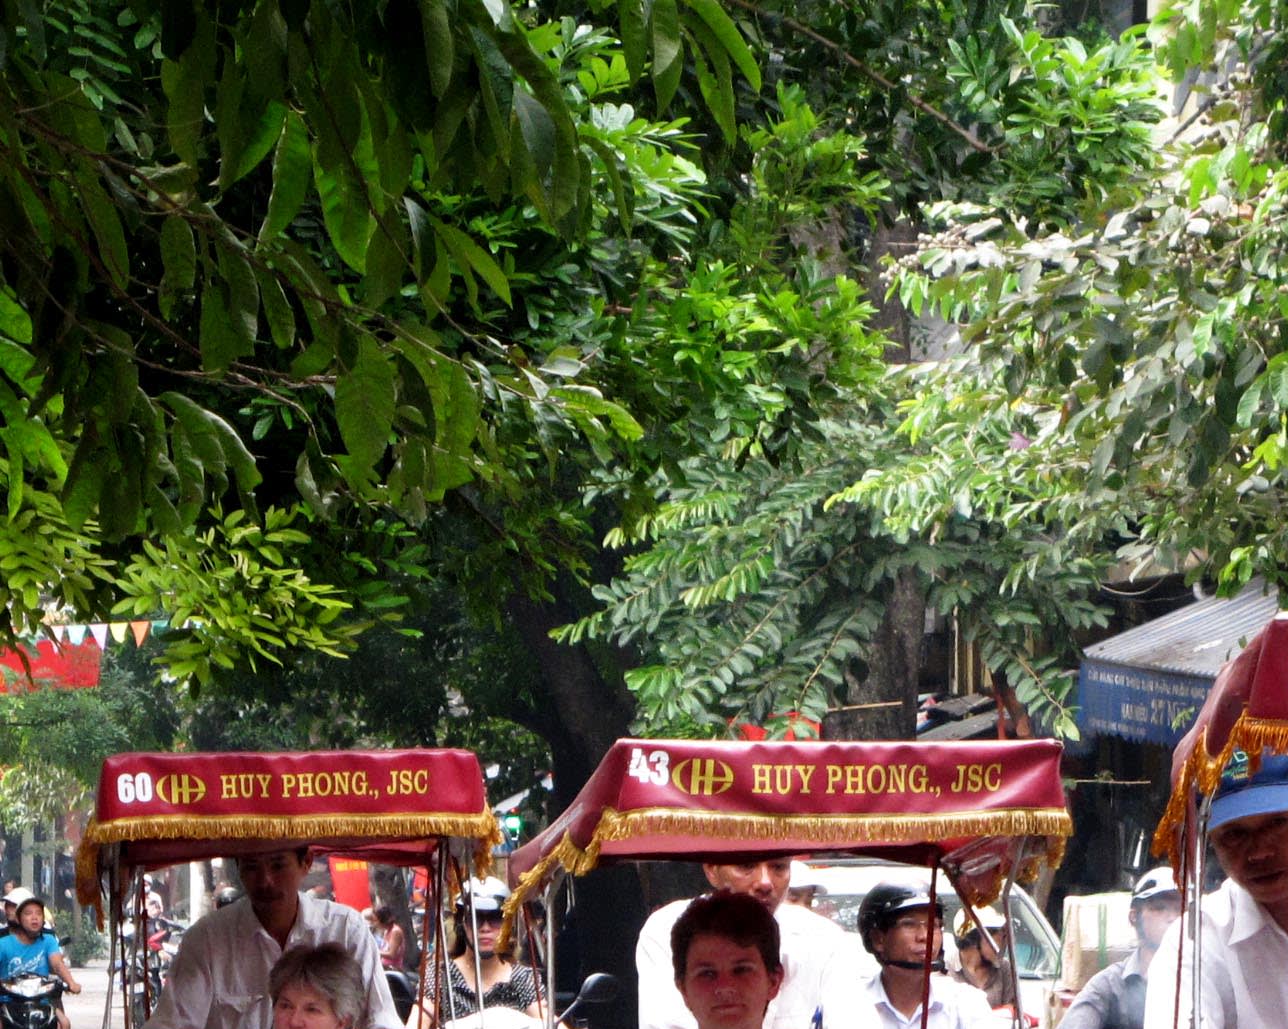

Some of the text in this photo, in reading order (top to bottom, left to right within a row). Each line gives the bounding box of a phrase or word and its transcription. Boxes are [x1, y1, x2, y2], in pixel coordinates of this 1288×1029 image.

[628, 748, 670, 787] 43
[751, 763, 812, 795] HUY
[950, 762, 1002, 793] JSC
[117, 772, 153, 804] 60
[220, 774, 272, 799] HUY
[387, 769, 429, 796] JSC
